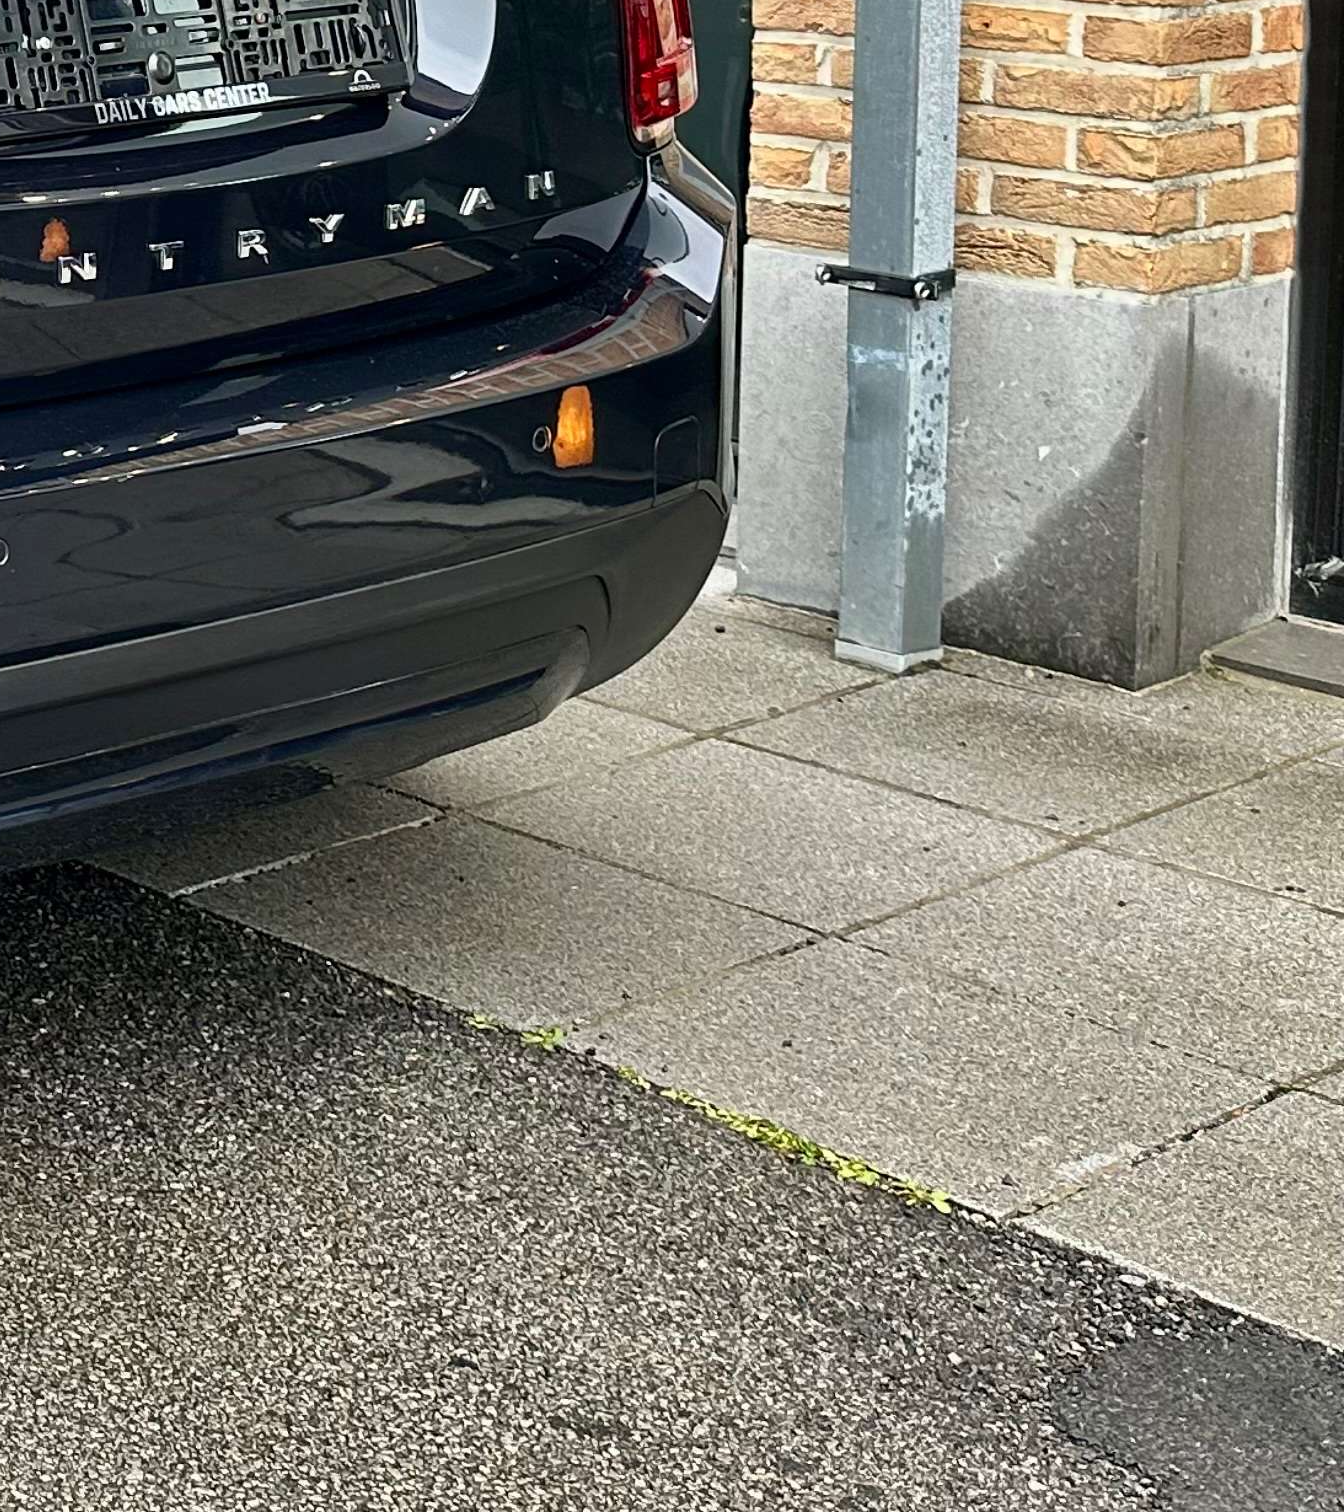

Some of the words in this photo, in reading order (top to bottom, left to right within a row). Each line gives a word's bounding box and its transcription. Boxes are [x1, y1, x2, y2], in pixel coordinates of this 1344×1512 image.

[94, 99, 147, 125] DAILY
[152, 92, 203, 117] CARS
[202, 82, 271, 109] CENTER
